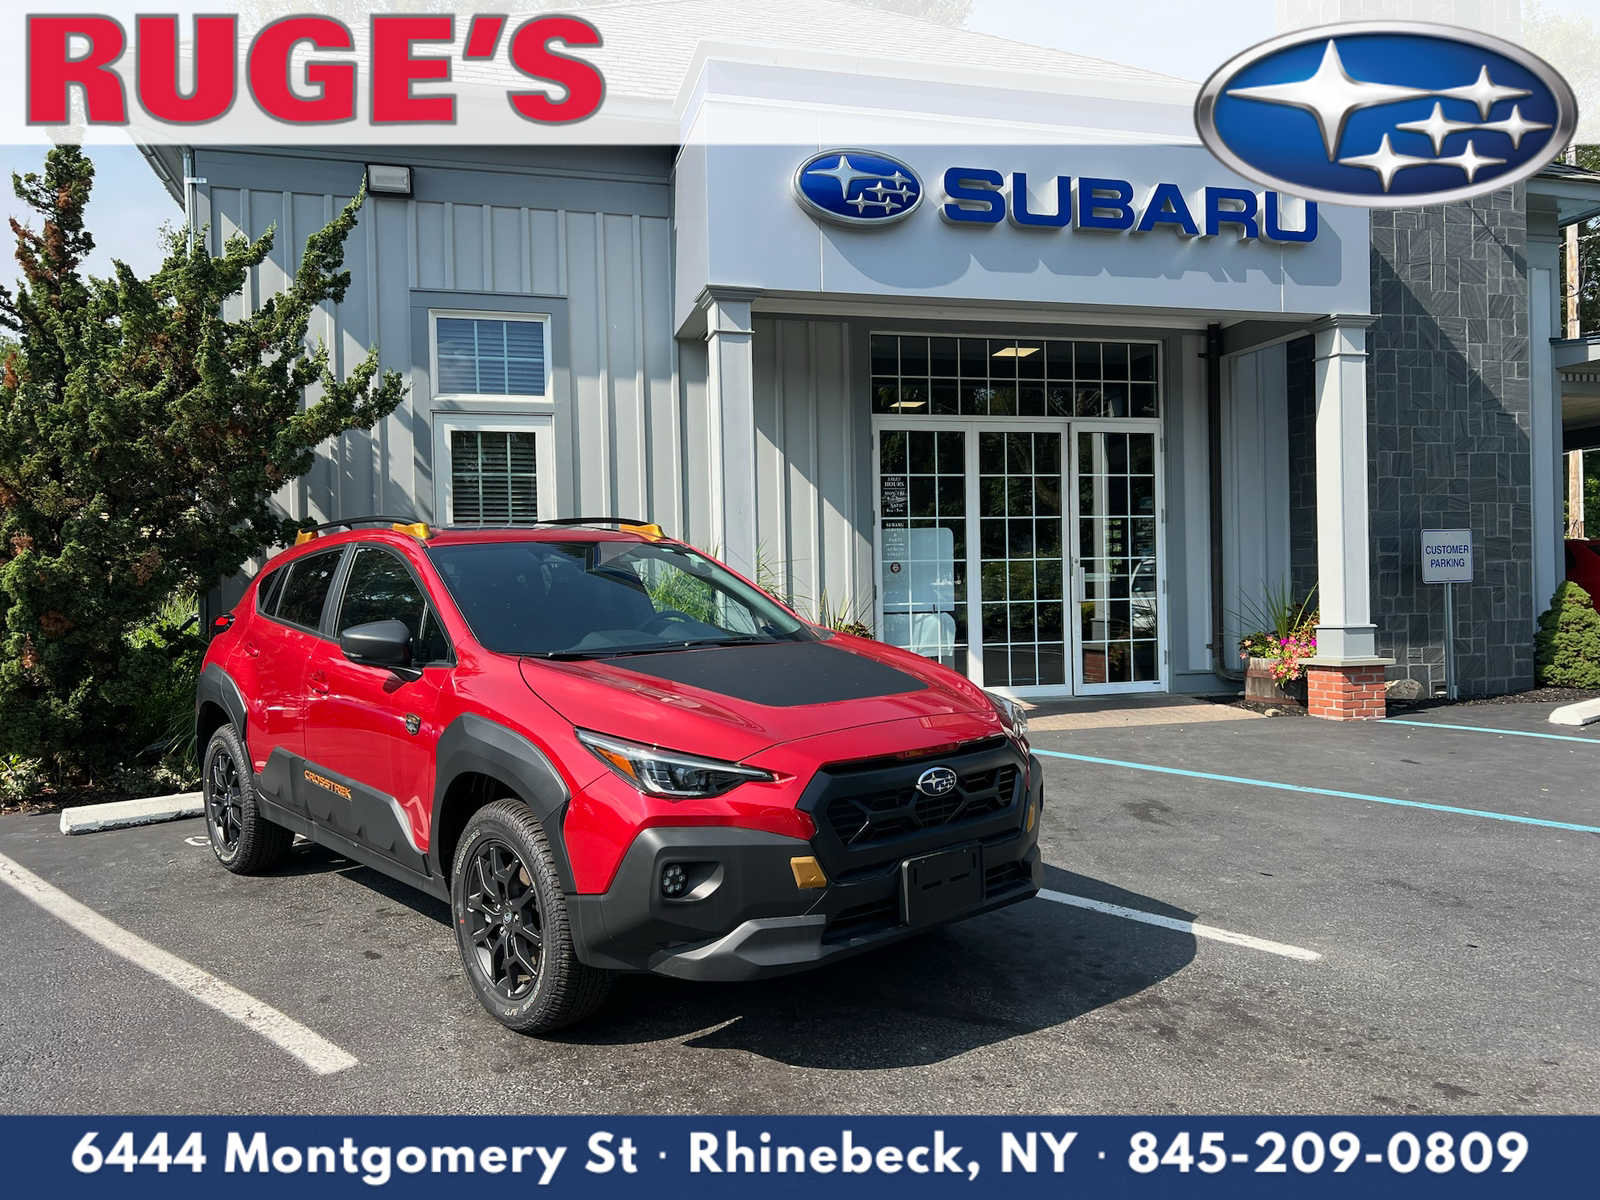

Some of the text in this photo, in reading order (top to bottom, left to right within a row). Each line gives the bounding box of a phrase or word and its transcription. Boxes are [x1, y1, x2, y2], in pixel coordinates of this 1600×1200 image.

[942, 166, 1319, 244] SUBARU
[1425, 544, 1469, 555] CUSTOMER
[1430, 558, 1465, 568] PARKING
[303, 769, 352, 801] CROSSTREK
